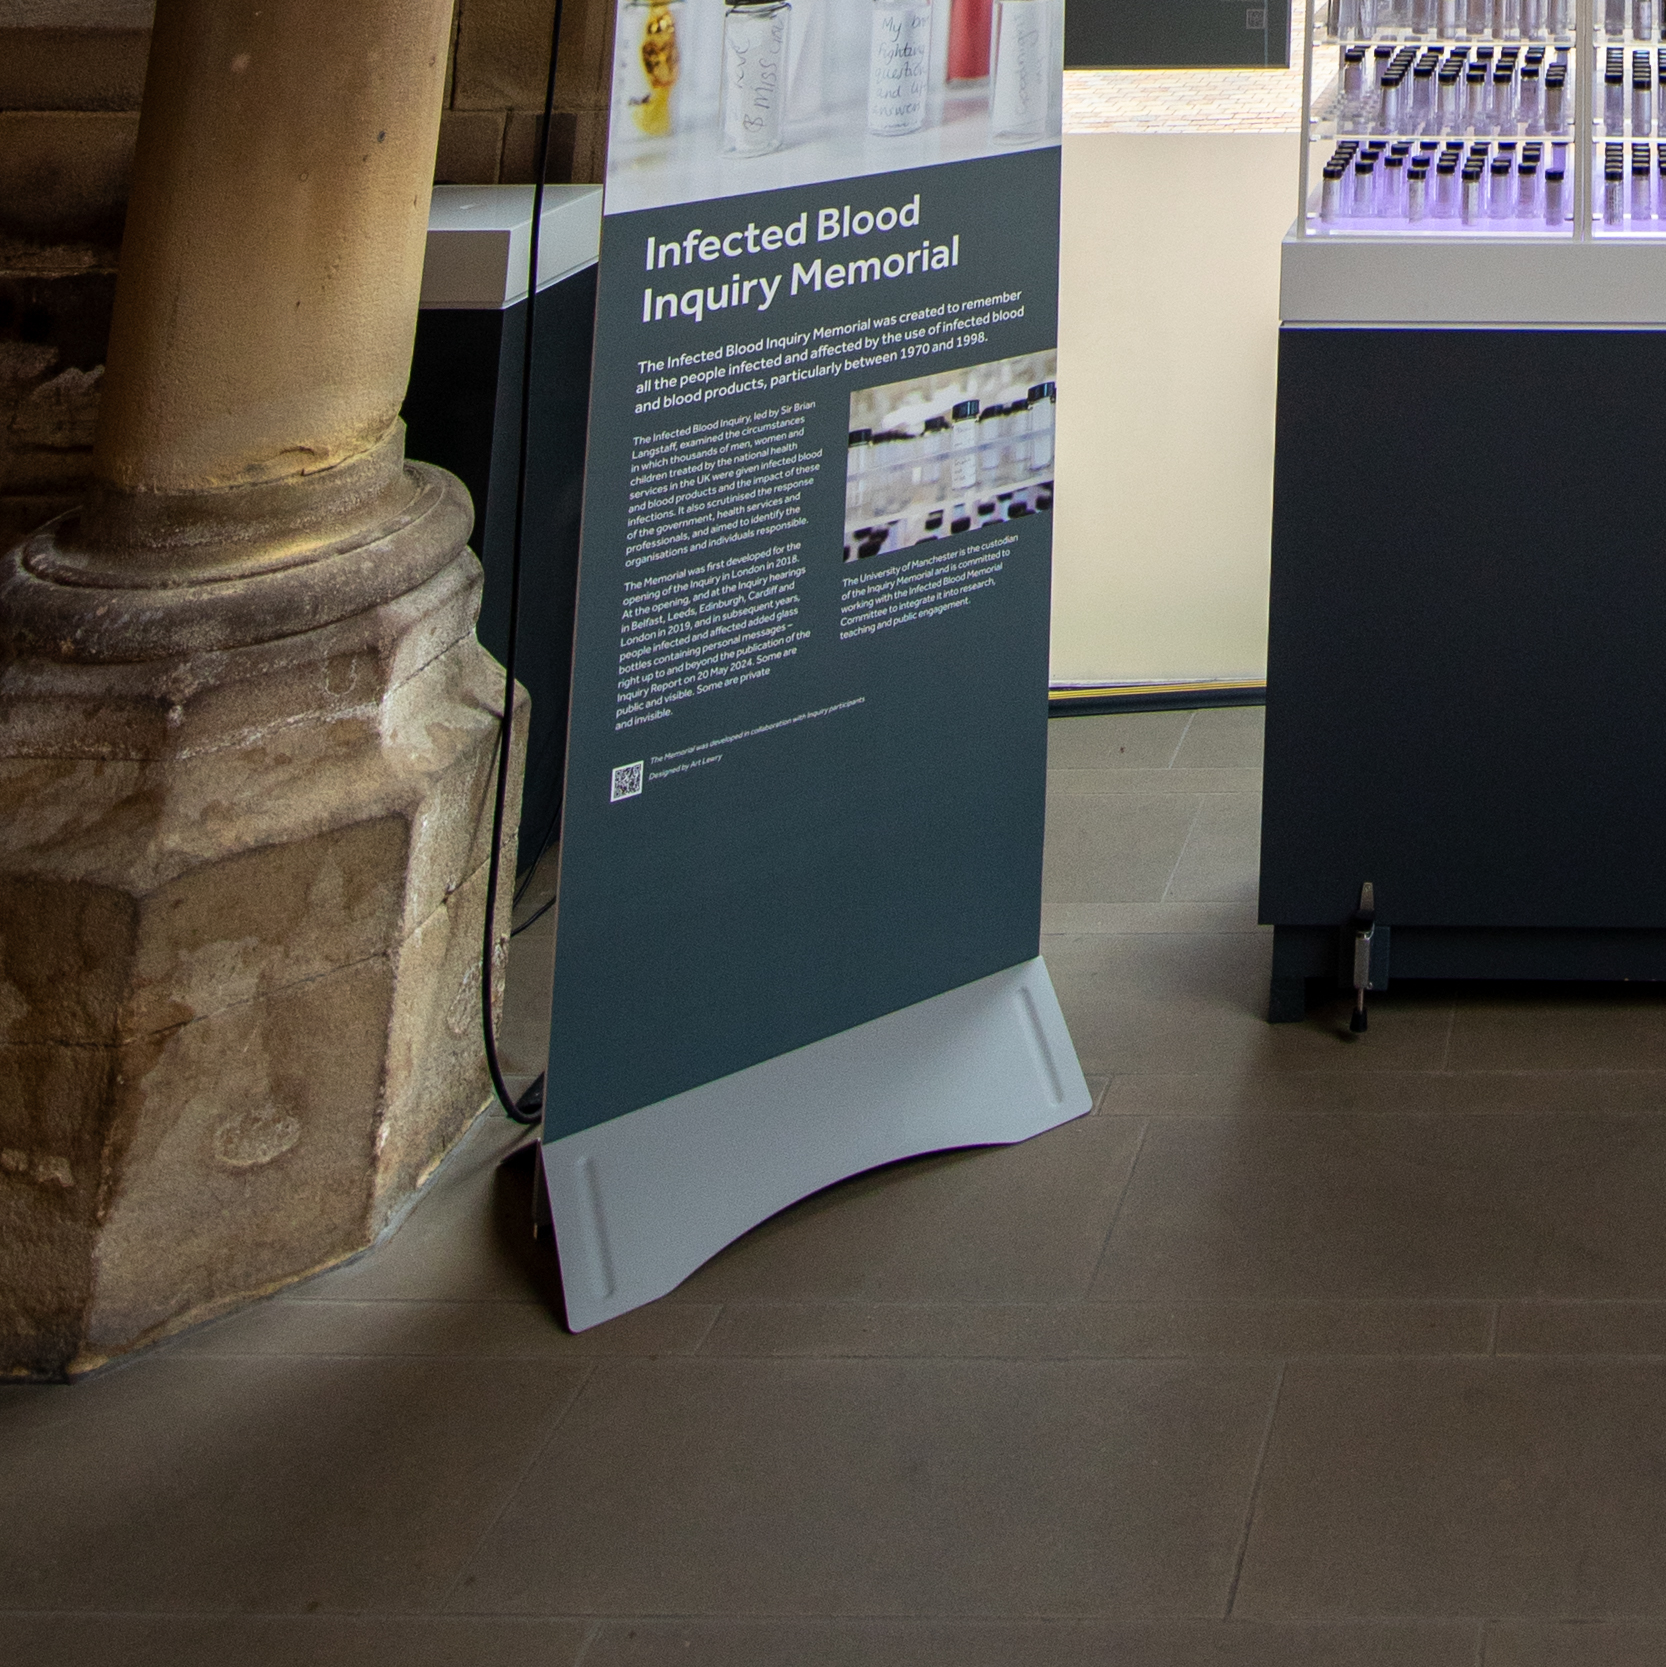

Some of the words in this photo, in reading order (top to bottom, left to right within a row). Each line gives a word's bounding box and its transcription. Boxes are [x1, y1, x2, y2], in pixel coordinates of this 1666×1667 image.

[646, 212, 807, 270] Infected
[817, 193, 920, 241] Blood
[642, 273, 781, 322] Inquiry
[790, 234, 958, 295] Memorial
[635, 379, 651, 394] all
[653, 376, 677, 390] the
[679, 366, 725, 387] people
[728, 353, 782, 375] infected
[784, 348, 808, 364] and
[809, 337, 862, 359] affected
[864, 336, 879, 349] by
[881, 332, 902, 344] the
[904, 327, 925, 340] use
[927, 321, 941, 335] of
[942, 311, 990, 332] infected
[992, 305, 1024, 322] blood
[637, 360, 664, 373] The
[667, 346, 723, 368] Infected
[725, 338, 763, 357] Blood
[765, 332, 810, 349] Inquiry
[812, 317, 870, 340] Memorial
[872, 315, 897, 328] was
[898, 303, 944, 323] created
[946, 303, 959, 313] to
[961, 290, 1022, 310] remember
[634, 396, 660, 413] and
[662, 388, 702, 408] blood
[703, 378, 767, 402] products,
[769, 361, 842, 388] particularly
[843, 351, 897, 370] between
[900, 342, 930, 359] 1970
[931, 337, 953, 352] and
[956, 331, 988, 347] 1998.
[630, 464, 639, 472] in
[640, 457, 668, 470] which
[669, 447, 718, 464] thousands
[719, 442, 729, 453] of
[730, 440, 752, 450] men,
[754, 432, 787, 445] women
[787, 427, 804, 438] and
[631, 441, 677, 459] Langstaff,
[679, 431, 723, 449] examined
[724, 430, 740, 439] the
[741, 415, 805, 436] circumstances
[632, 436, 651, 445] The
[652, 425, 691, 441] Infected
[692, 419, 718, 433] Blood
[719, 415, 751, 427] Inquiry,
[753, 409, 767, 420] led
[768, 408, 779, 418] by
[780, 405, 792, 415] Sir
[793, 401, 815, 412] Brian
[629, 484, 668, 500] services
[669, 482, 678, 490] in
[679, 478, 695, 488] the
[696, 473, 710, 484] UK
[711, 470, 734, 480] were
[735, 464, 759, 478] given
[760, 454, 796, 470] infected
[797, 448, 822, 462] blood
[842, 577, 858, 587] The
[859, 566, 900, 583] University
[901, 561, 911, 572] of
[911, 550, 958, 568] Manchester
[958, 548, 965, 556] is
[966, 545, 980, 554] the
[980, 534, 1018, 550] custodian
[621, 609, 632, 619] At
[634, 606, 650, 616] the
[651, 596, 690, 612] opening,
[692, 589, 709, 601] and
[710, 587, 719, 597] at
[721, 584, 736, 594] the
[737, 576, 768, 589] Inquiry
[768, 566, 806, 581] hearings
[616, 687, 649, 702] Inquiry
[650, 677, 682, 692] Report
[683, 674, 695, 684] on
[697, 669, 709, 680] 20
[709, 666, 728, 676] May
[729, 657, 755, 671] 2024.
[756, 651, 782, 664] Some
[782, 647, 797, 657] are
